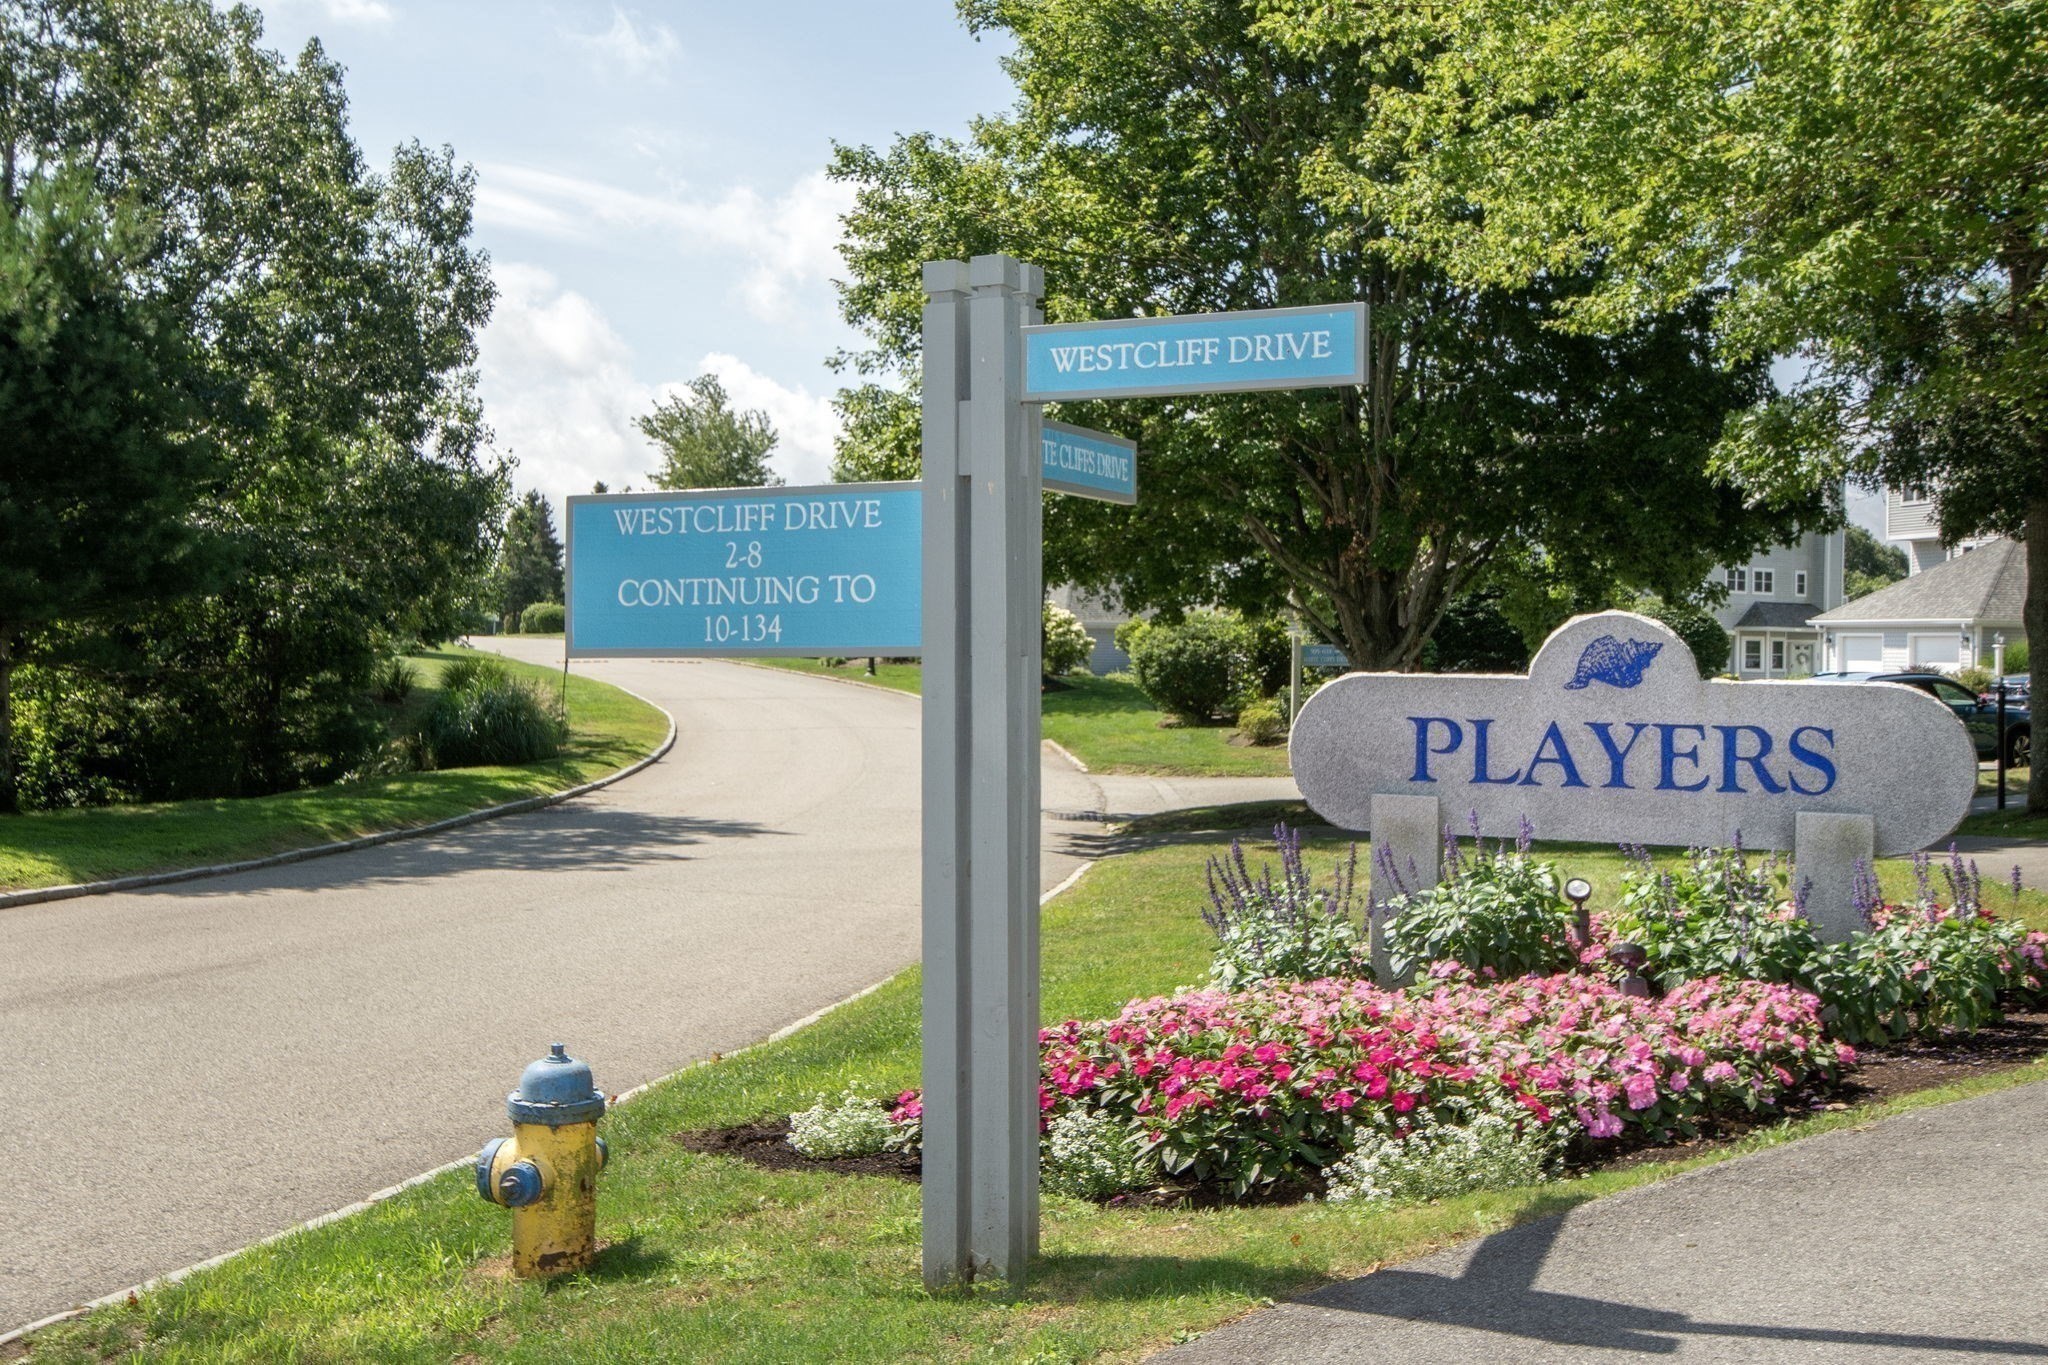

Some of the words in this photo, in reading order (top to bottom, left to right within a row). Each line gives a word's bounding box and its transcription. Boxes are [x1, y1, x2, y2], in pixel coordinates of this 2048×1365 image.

[1050, 337, 1220, 373] WESTCLIFF
[1228, 330, 1333, 364] DRIVE
[1042, 439, 1058, 466] TE
[1060, 444, 1096, 474] CLIFFS
[1097, 452, 1130, 482] DRIVE
[614, 503, 776, 535] WESTCLIFF
[784, 499, 883, 531] DRIVE
[725, 540, 762, 569] 2-8
[617, 575, 820, 607] CONTINUING
[828, 573, 877, 604] TO
[704, 613, 783, 643] 10-134
[1406, 716, 1838, 796] PLAYERS
